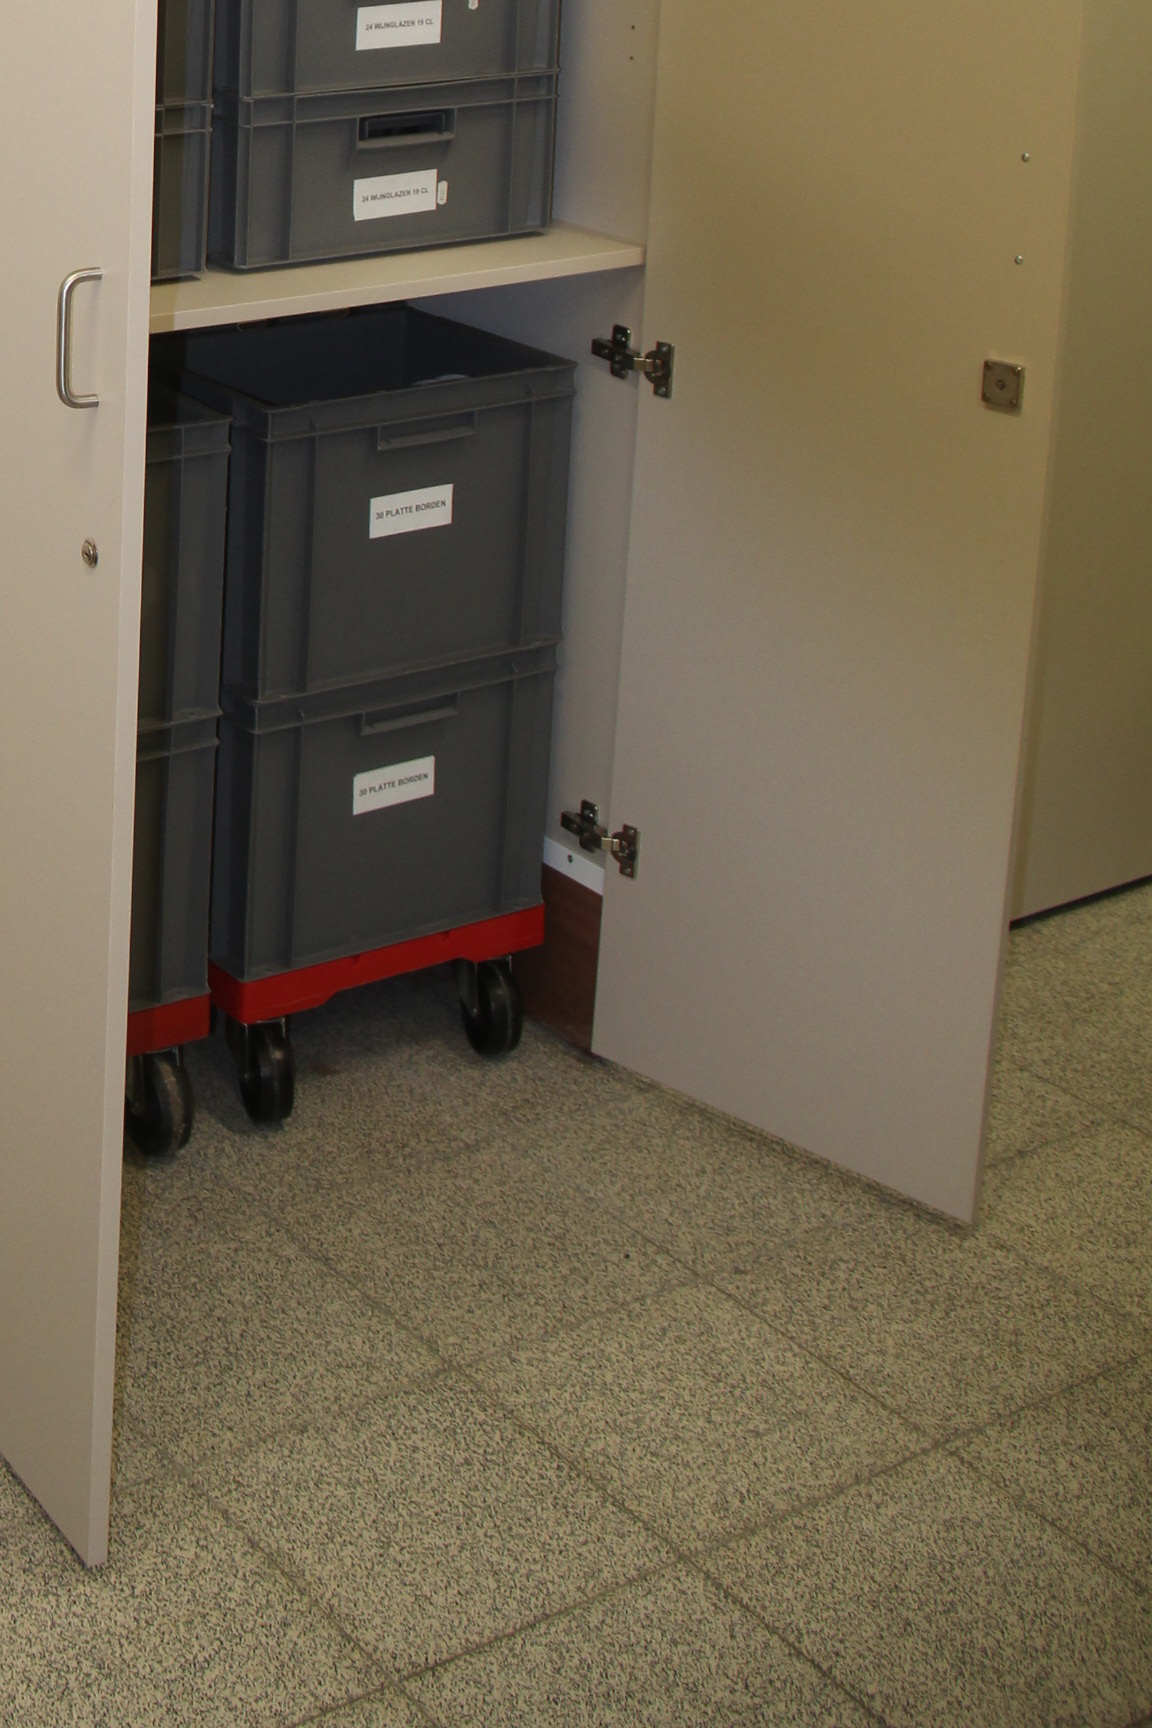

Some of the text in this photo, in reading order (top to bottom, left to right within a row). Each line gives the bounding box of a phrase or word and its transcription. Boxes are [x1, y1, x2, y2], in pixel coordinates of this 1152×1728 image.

[385, 505, 414, 518] PLATTE
[415, 499, 446, 512] BORDEN
[368, 780, 396, 794] PLATTE
[397, 772, 429, 786] BORDEN
